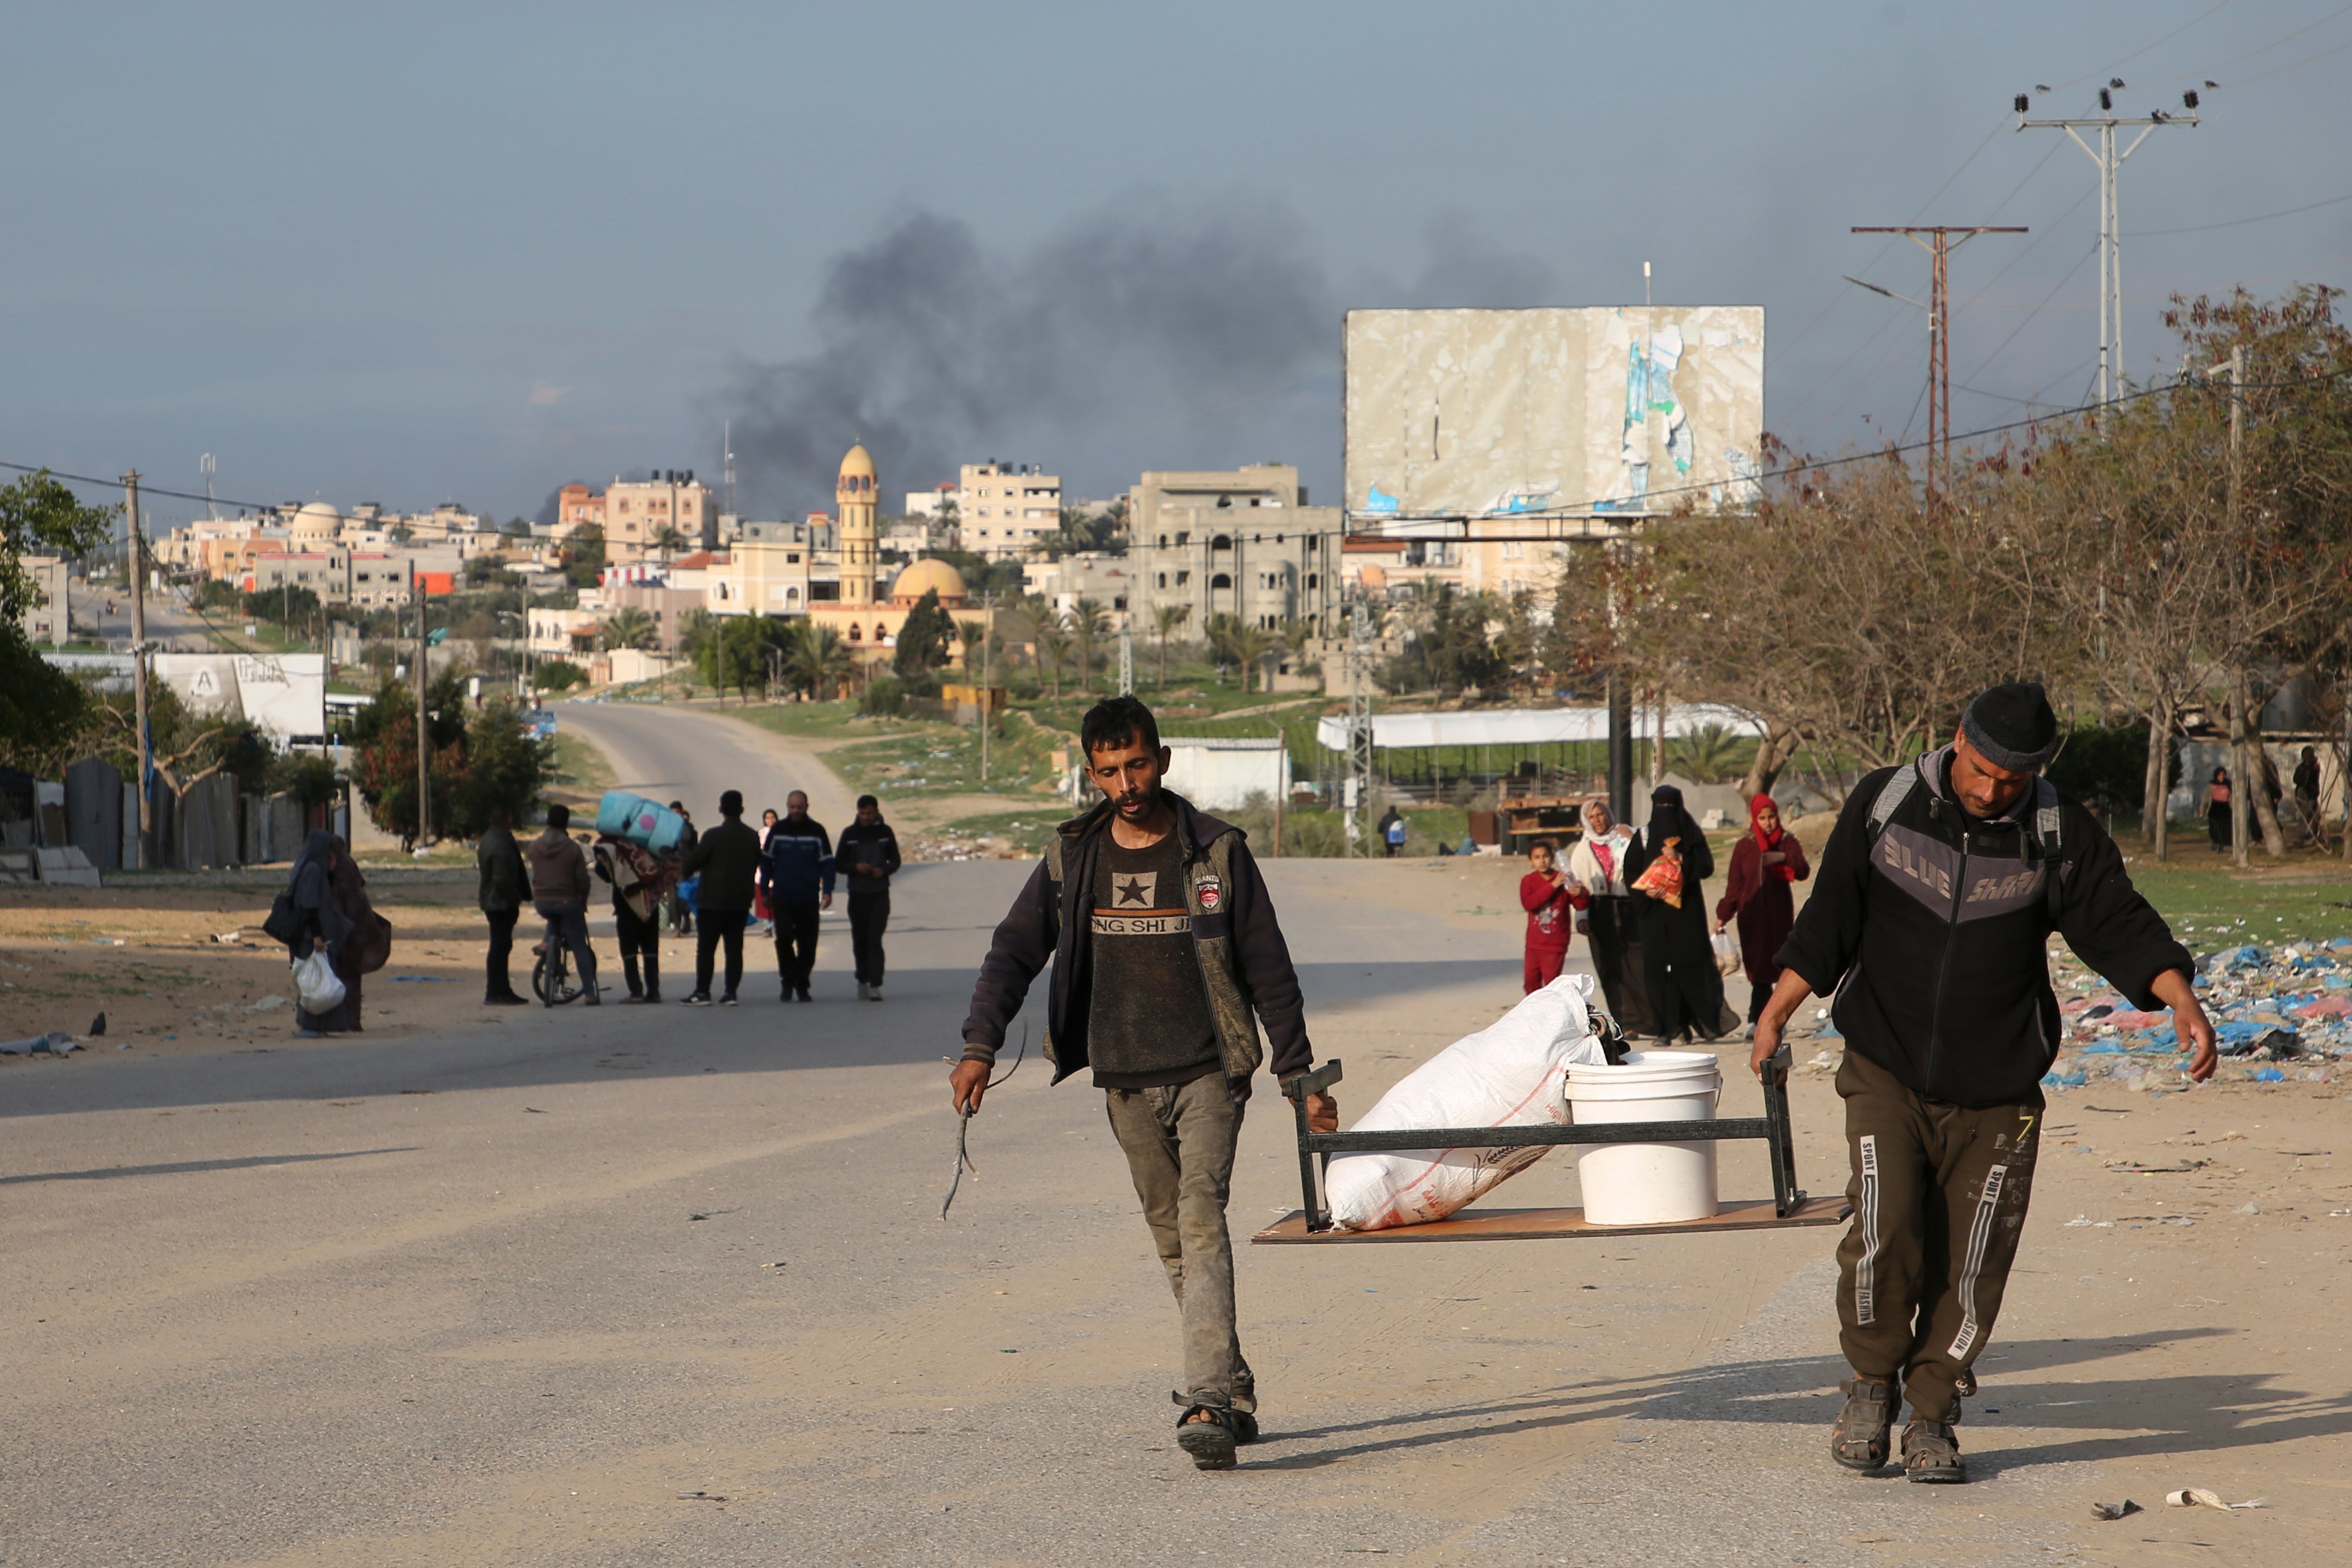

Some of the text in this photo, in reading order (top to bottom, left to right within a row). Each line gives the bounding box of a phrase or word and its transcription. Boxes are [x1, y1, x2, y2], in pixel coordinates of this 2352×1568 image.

[1195, 874, 1219, 885] GIANTS
[1131, 919, 1166, 932] SHI
[2016, 1116, 2035, 1141] 7
[1862, 1142, 1874, 1170] SPORT
[1985, 1171, 2002, 1198] SPORT
[1858, 1292, 1871, 1321] FASHION
[1954, 1315, 1976, 1353] ASHION
